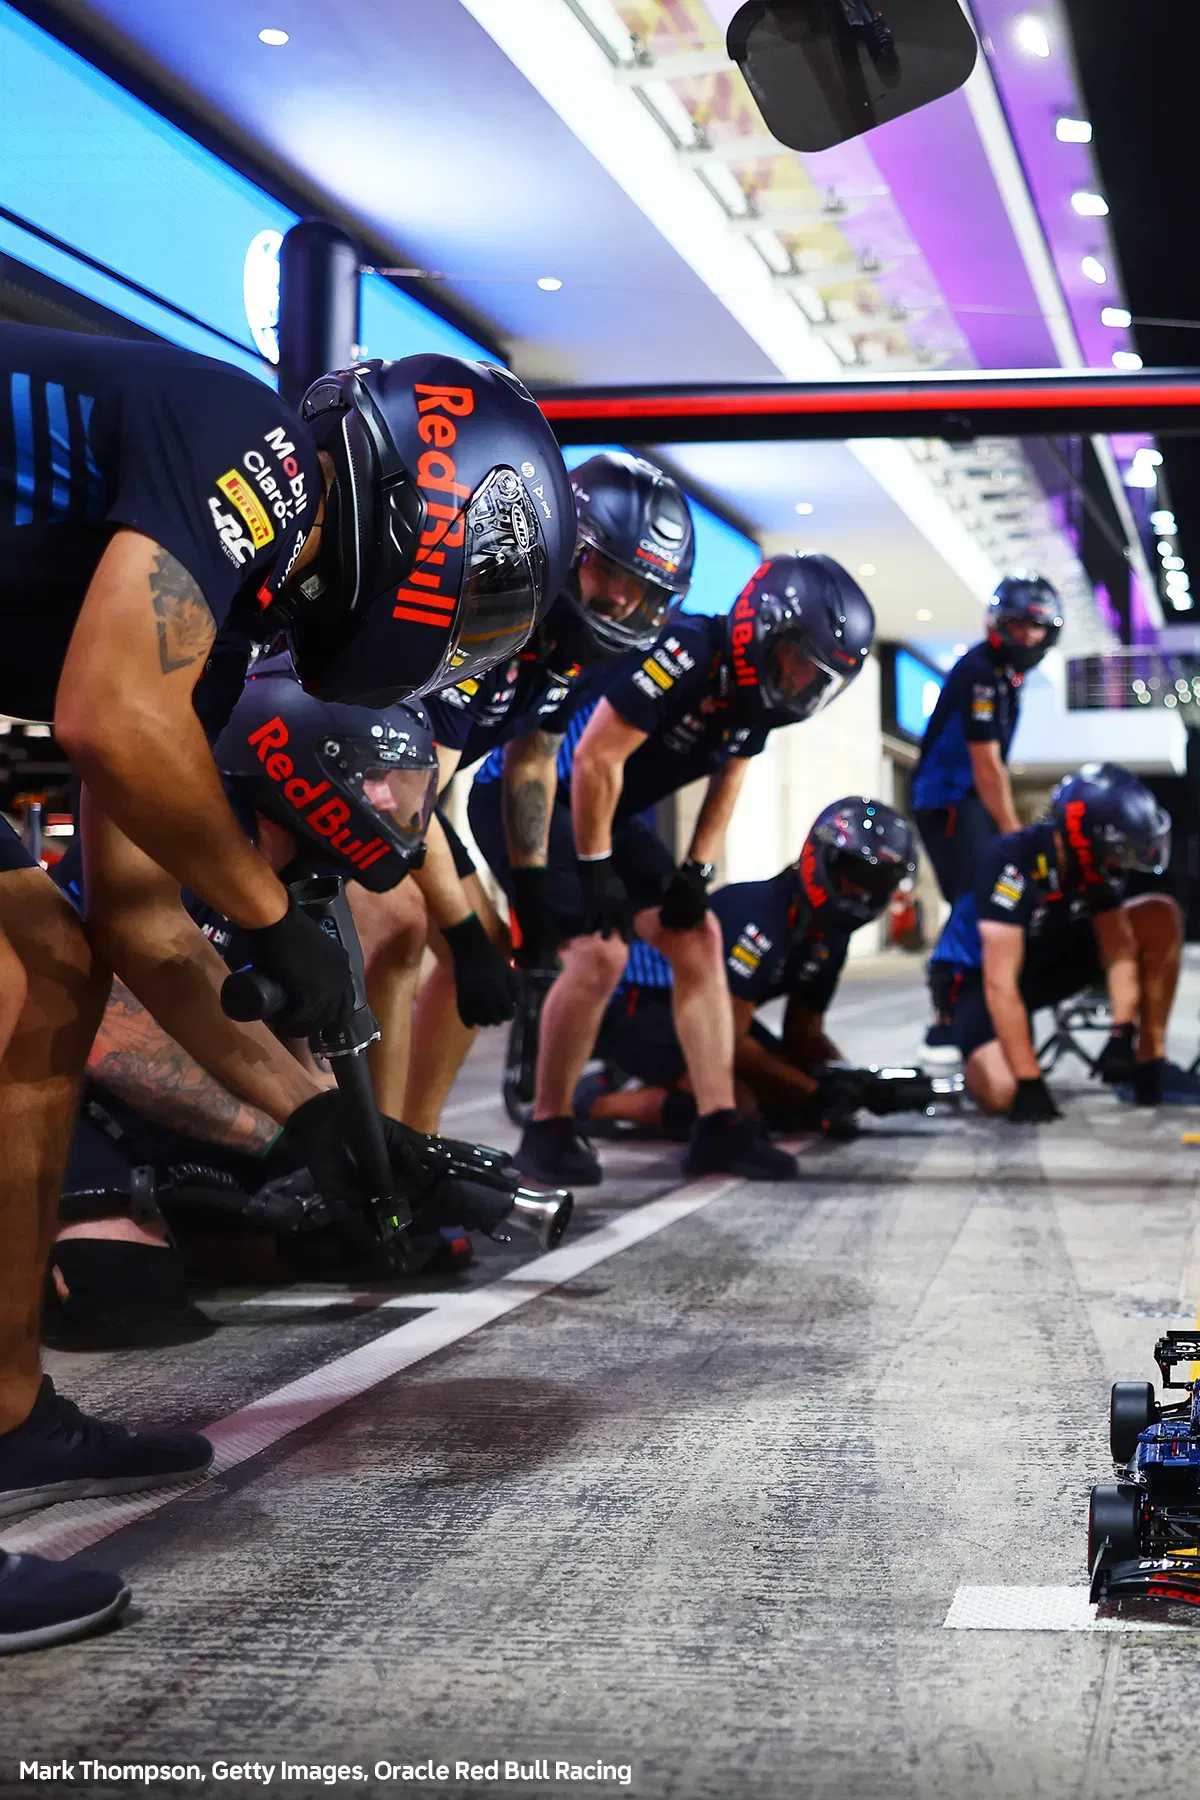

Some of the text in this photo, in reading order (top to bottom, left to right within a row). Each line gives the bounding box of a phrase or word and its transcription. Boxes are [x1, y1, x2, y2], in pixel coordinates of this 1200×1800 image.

[244, 451, 288, 520] Claro
[264, 427, 307, 515] Mobil
[247, 716, 391, 870] Red Bull
